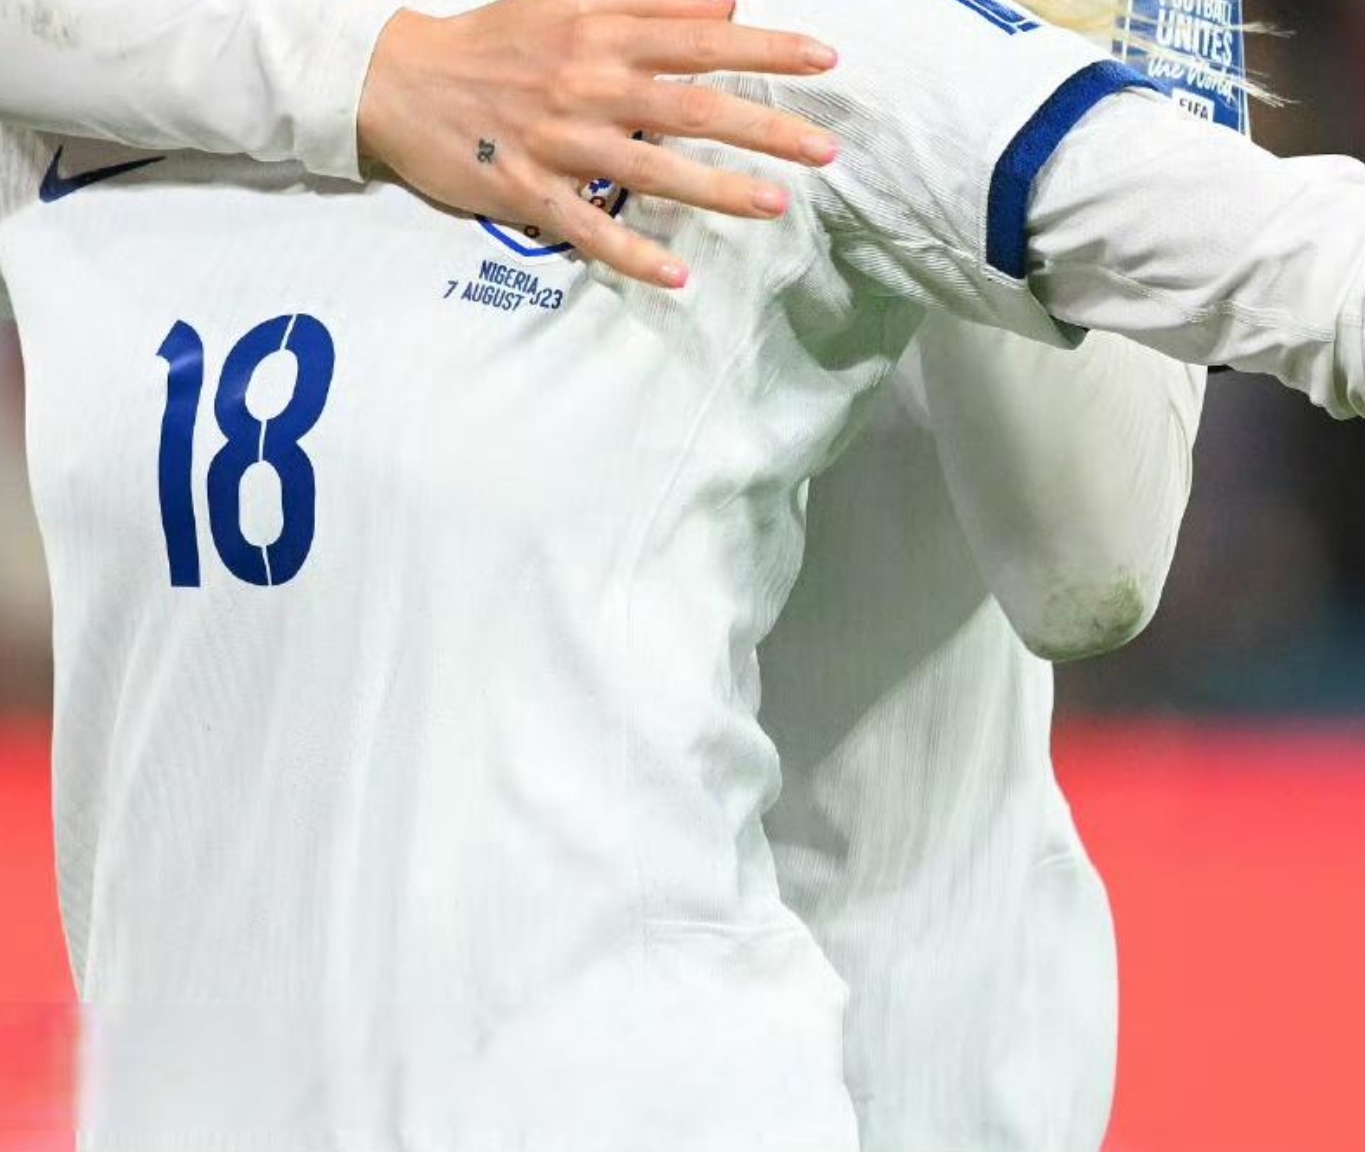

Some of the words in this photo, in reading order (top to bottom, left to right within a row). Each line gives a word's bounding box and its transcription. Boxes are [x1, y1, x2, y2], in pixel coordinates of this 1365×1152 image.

[1156, 8, 1233, 67] UNITES
[443, 280, 458, 299] 7
[460, 281, 525, 311] AUGUST
[478, 259, 538, 296] NIGERIA
[155, 313, 336, 588] 18
